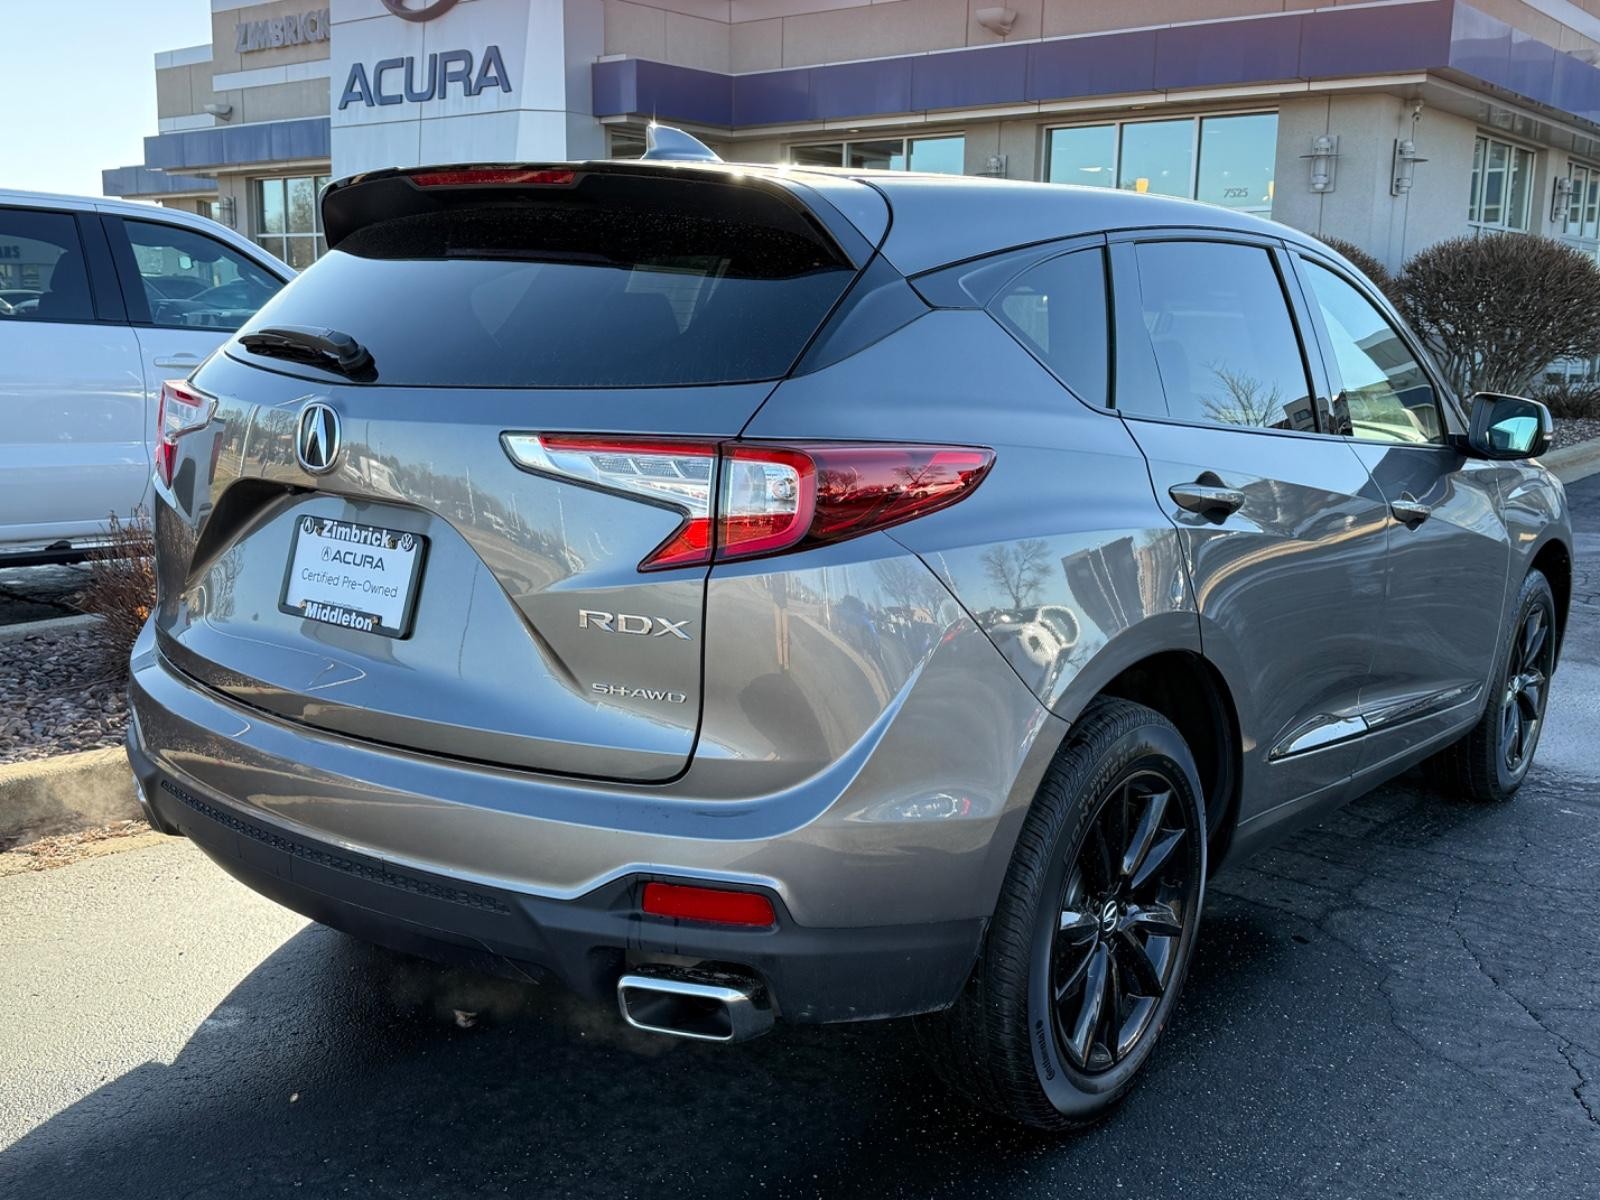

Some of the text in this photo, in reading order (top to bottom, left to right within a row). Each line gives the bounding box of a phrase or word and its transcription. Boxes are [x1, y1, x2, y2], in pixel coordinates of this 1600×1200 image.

[235, 8, 330, 53] ZIMBRICK
[338, 45, 512, 110] ACURA
[1223, 187, 1248, 198] 7525
[321, 520, 391, 548] Zimbrick
[331, 550, 385, 571] ACURA
[301, 568, 398, 598] Certified Pre-Owned
[304, 602, 373, 631] Middleton
[579, 609, 694, 640] RDX
